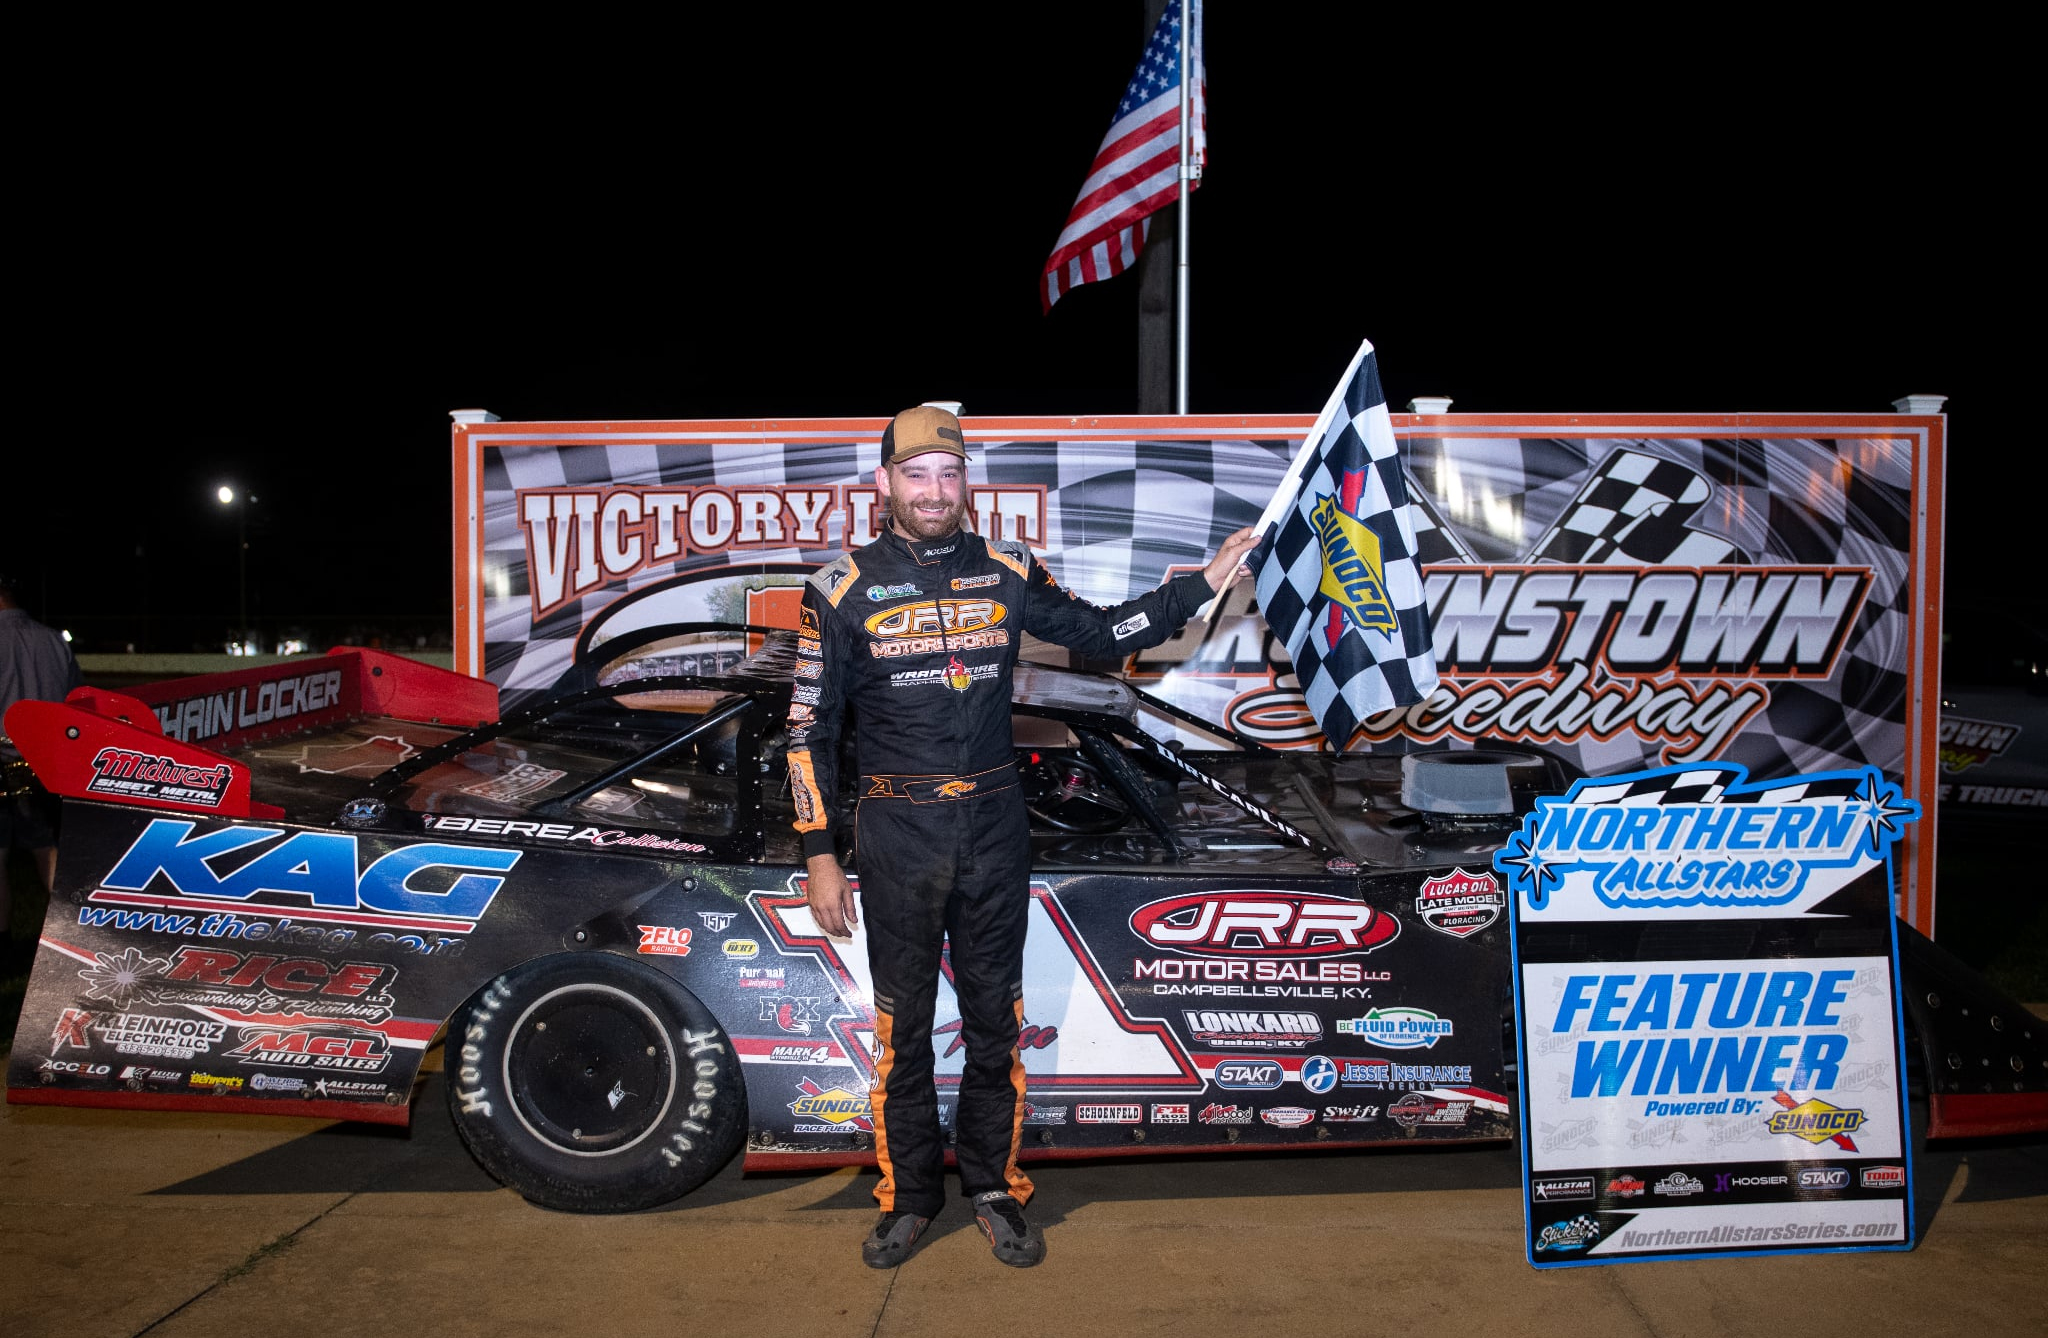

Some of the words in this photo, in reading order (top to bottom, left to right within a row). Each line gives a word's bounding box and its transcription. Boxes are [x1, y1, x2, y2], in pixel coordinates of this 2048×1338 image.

[522, 489, 834, 614] VICTORY
[1314, 502, 1395, 625] SUNOCO
[876, 602, 994, 635] JRR
[870, 629, 1009, 658] MOTORSPORTS
[238, 670, 342, 728] LOCKER
[100, 750, 225, 789] Midwest
[95, 779, 155, 792] SHEET
[160, 786, 217, 800] METAL
[434, 817, 603, 841] BEREA
[591, 829, 706, 853] Collision
[1538, 803, 1857, 852] NORTHERN
[101, 819, 524, 921] KAG
[1605, 856, 1804, 896] ALLSTARS
[1430, 882, 1468, 896] LUCAS
[1471, 880, 1489, 892] OIL
[1420, 898, 1453, 910] LATE
[1455, 894, 1501, 905] MODEL
[1149, 900, 1372, 947] JRR
[653, 926, 692, 944] FLO
[651, 945, 678, 953] RACING
[165, 949, 385, 997] RICE
[1135, 959, 1248, 981] MOTOR
[1256, 962, 1361, 982] SALES
[1364, 971, 1391, 980] LLC
[1153, 984, 1338, 1000] CAMPBELLSVILLE,
[1342, 987, 1372, 998] KY.
[1553, 970, 1855, 1033] FEATURE
[158, 990, 254, 1009] Excavating
[258, 995, 281, 1009] &
[284, 998, 386, 1020] Plumbing
[760, 996, 820, 1036] FOX
[1186, 1012, 1322, 1034] LONKARD
[94, 1013, 226, 1040] KLEINHOLZ
[1355, 1020, 1395, 1033] FLUID
[1400, 1020, 1451, 1033] POWER
[106, 1030, 175, 1045] ELECTRIC
[178, 1037, 207, 1050] LLC.
[240, 1032, 385, 1059] MGL
[1210, 1039, 1274, 1049] Union,
[252, 1052, 306, 1064] AUTO
[314, 1056, 381, 1070] SALES
[771, 1046, 813, 1056] MARK
[810, 1046, 829, 1062] 4
[40, 1058, 111, 1075] ACCELO
[1221, 1066, 1277, 1082] STAKT
[1571, 1034, 1849, 1098] WINNER
[326, 1080, 387, 1091] ALLSTAR
[1377, 1081, 1436, 1091] AGENCY
[661, 1027, 725, 1168] Hoosier
[1645, 1099, 1728, 1116] Powered
[1732, 1098, 1763, 1115] By:
[1079, 1106, 1139, 1119] SCHOENFELD
[1323, 1104, 1381, 1119] Swift
[1773, 1112, 1858, 1131] SUNOCO
[794, 1124, 824, 1133] RACE
[825, 1124, 855, 1132] FUELS
[1545, 1181, 1591, 1189] ALLSTAR
[1732, 1176, 1788, 1186] HOOSIER
[1800, 1171, 1846, 1185] STAKT
[1866, 1172, 1899, 1180] TODD
[1545, 1188, 1592, 1196] PERFORMANCE
[1621, 1222, 1898, 1248] NorthernAllstarsSeries.com
